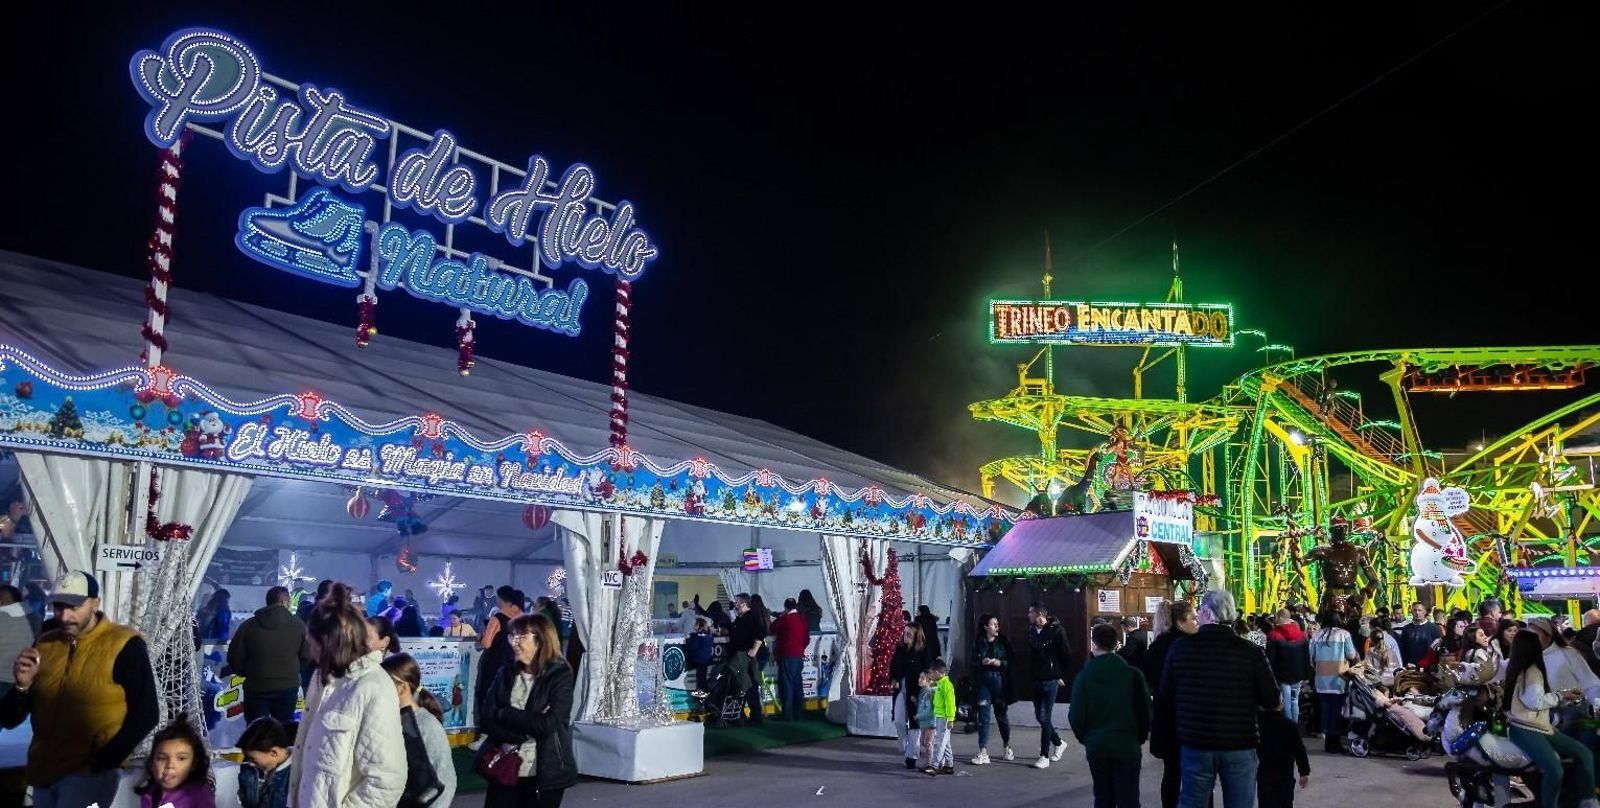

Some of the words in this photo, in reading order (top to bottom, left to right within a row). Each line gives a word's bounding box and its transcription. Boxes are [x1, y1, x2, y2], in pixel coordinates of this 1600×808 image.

[132, 28, 391, 191] Pista
[391, 131, 477, 222] de
[486, 156, 657, 279] Hielo
[378, 224, 588, 336] Natural
[995, 304, 1071, 337] TRINEO
[1076, 304, 1228, 338] ENCANTADO
[229, 423, 268, 461] El
[268, 427, 341, 466] Hielo
[345, 448, 372, 470] es
[378, 443, 464, 483] Magia
[467, 462, 492, 484] en
[499, 461, 586, 495] Navidad
[1151, 520, 1191, 543] CENTRAL
[102, 548, 160, 561] SERVICIOS
[603, 572, 618, 583] WC
